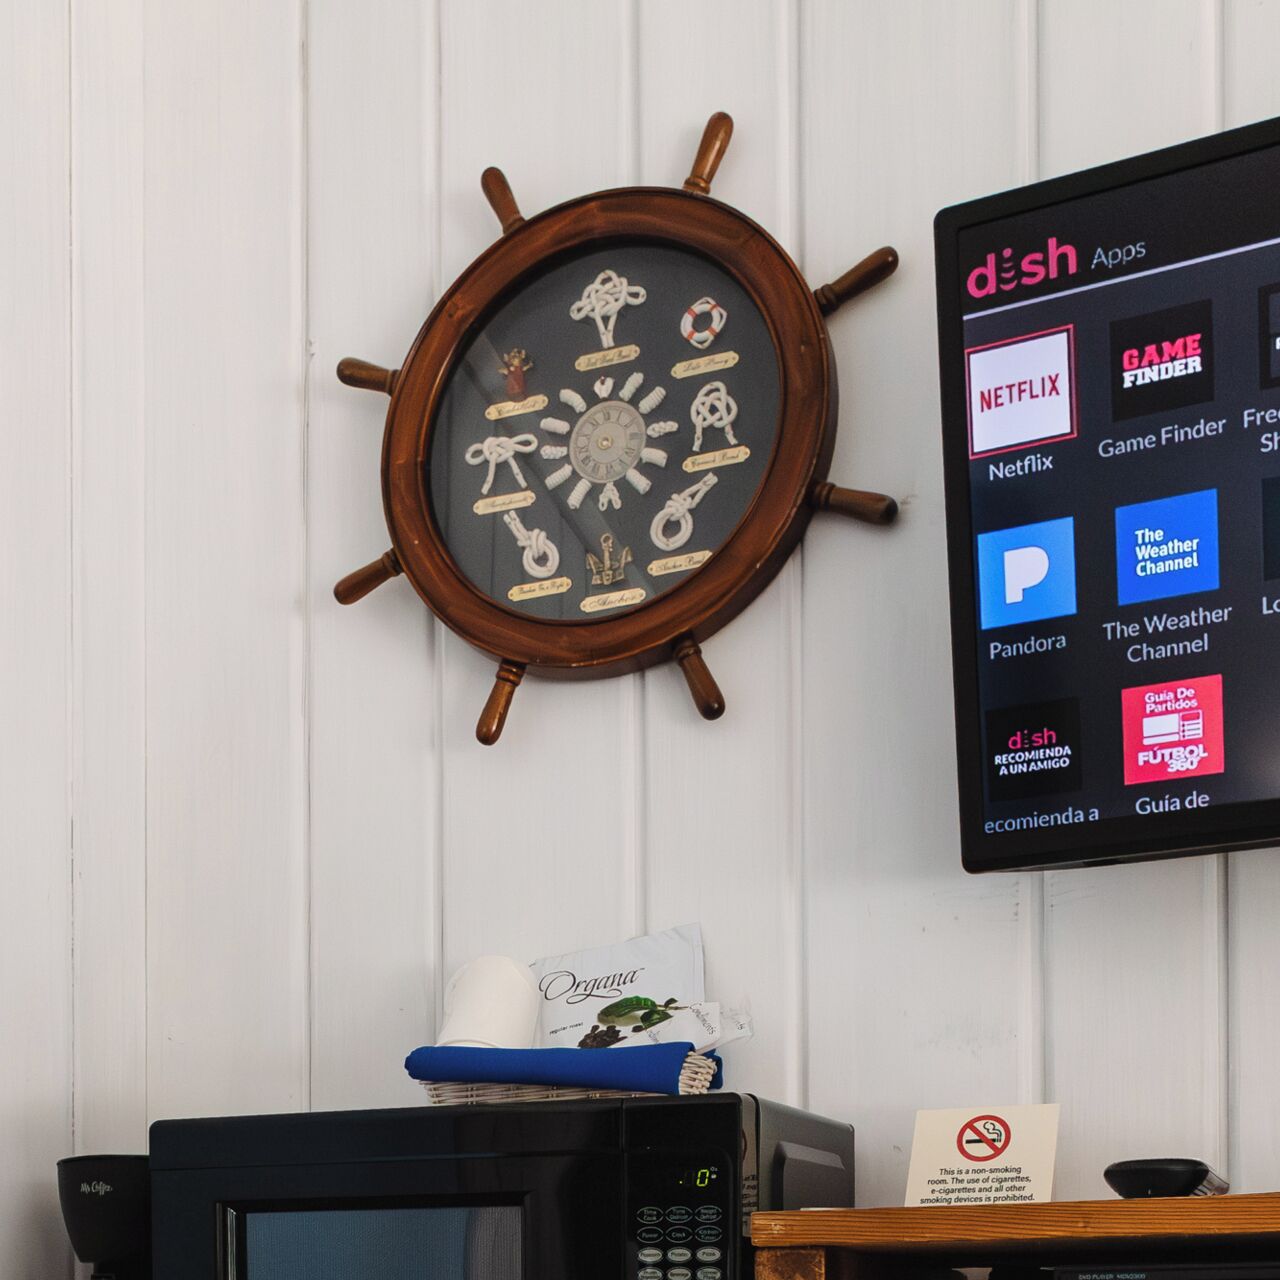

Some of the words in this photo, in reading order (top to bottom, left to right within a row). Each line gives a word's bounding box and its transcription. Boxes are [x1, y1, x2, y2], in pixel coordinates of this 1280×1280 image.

[966, 236, 1078, 299] dish
[1091, 241, 1147, 270] Apps
[1122, 333, 1203, 370] GAME
[1122, 355, 1203, 389] FINDER
[979, 372, 1061, 413] NETFLIX
[1098, 432, 1158, 458] Game
[1160, 417, 1228, 445] Finder
[988, 453, 1054, 481] Netflix
[1135, 527, 1164, 545] The
[1135, 537, 1200, 561] Weather
[1135, 552, 1199, 577] Channel
[1102, 621, 1141, 642] The
[1143, 605, 1233, 634] Weather
[989, 633, 1067, 660] Pandora
[1126, 633, 1209, 663] Channel
[1176, 687, 1195, 700] De
[1145, 697, 1198, 715] Partidos
[1008, 727, 1057, 750] dish
[994, 744, 1072, 766] RECOMIENDA
[998, 764, 1009, 776] A
[1009, 761, 1028, 775] UN
[1027, 757, 1070, 773] AMIGO
[1137, 743, 1208, 766] FÚTBOL
[1087, 806, 1100, 822] a
[1135, 795, 1181, 816] Guía
[1184, 790, 1210, 809] de
[538, 967, 640, 1005] Organa
[939, 1168, 955, 1176] This
[956, 1167, 963, 1175] is
[971, 1165, 1022, 1175] non-smoking
[951, 1177, 965, 1185] The
[981, 1176, 991, 1184] of
[990, 1175, 1032, 1185] cigarettes,
[920, 1195, 952, 1205] smoking
[953, 1195, 983, 1203] devices
[984, 1194, 992, 1202] is
[993, 1193, 1035, 1203] prohibited.
[931, 1186, 976, 1196] e-cigarettes
[994, 1184, 1003, 1192] all
[1005, 1184, 1026, 1192] other
